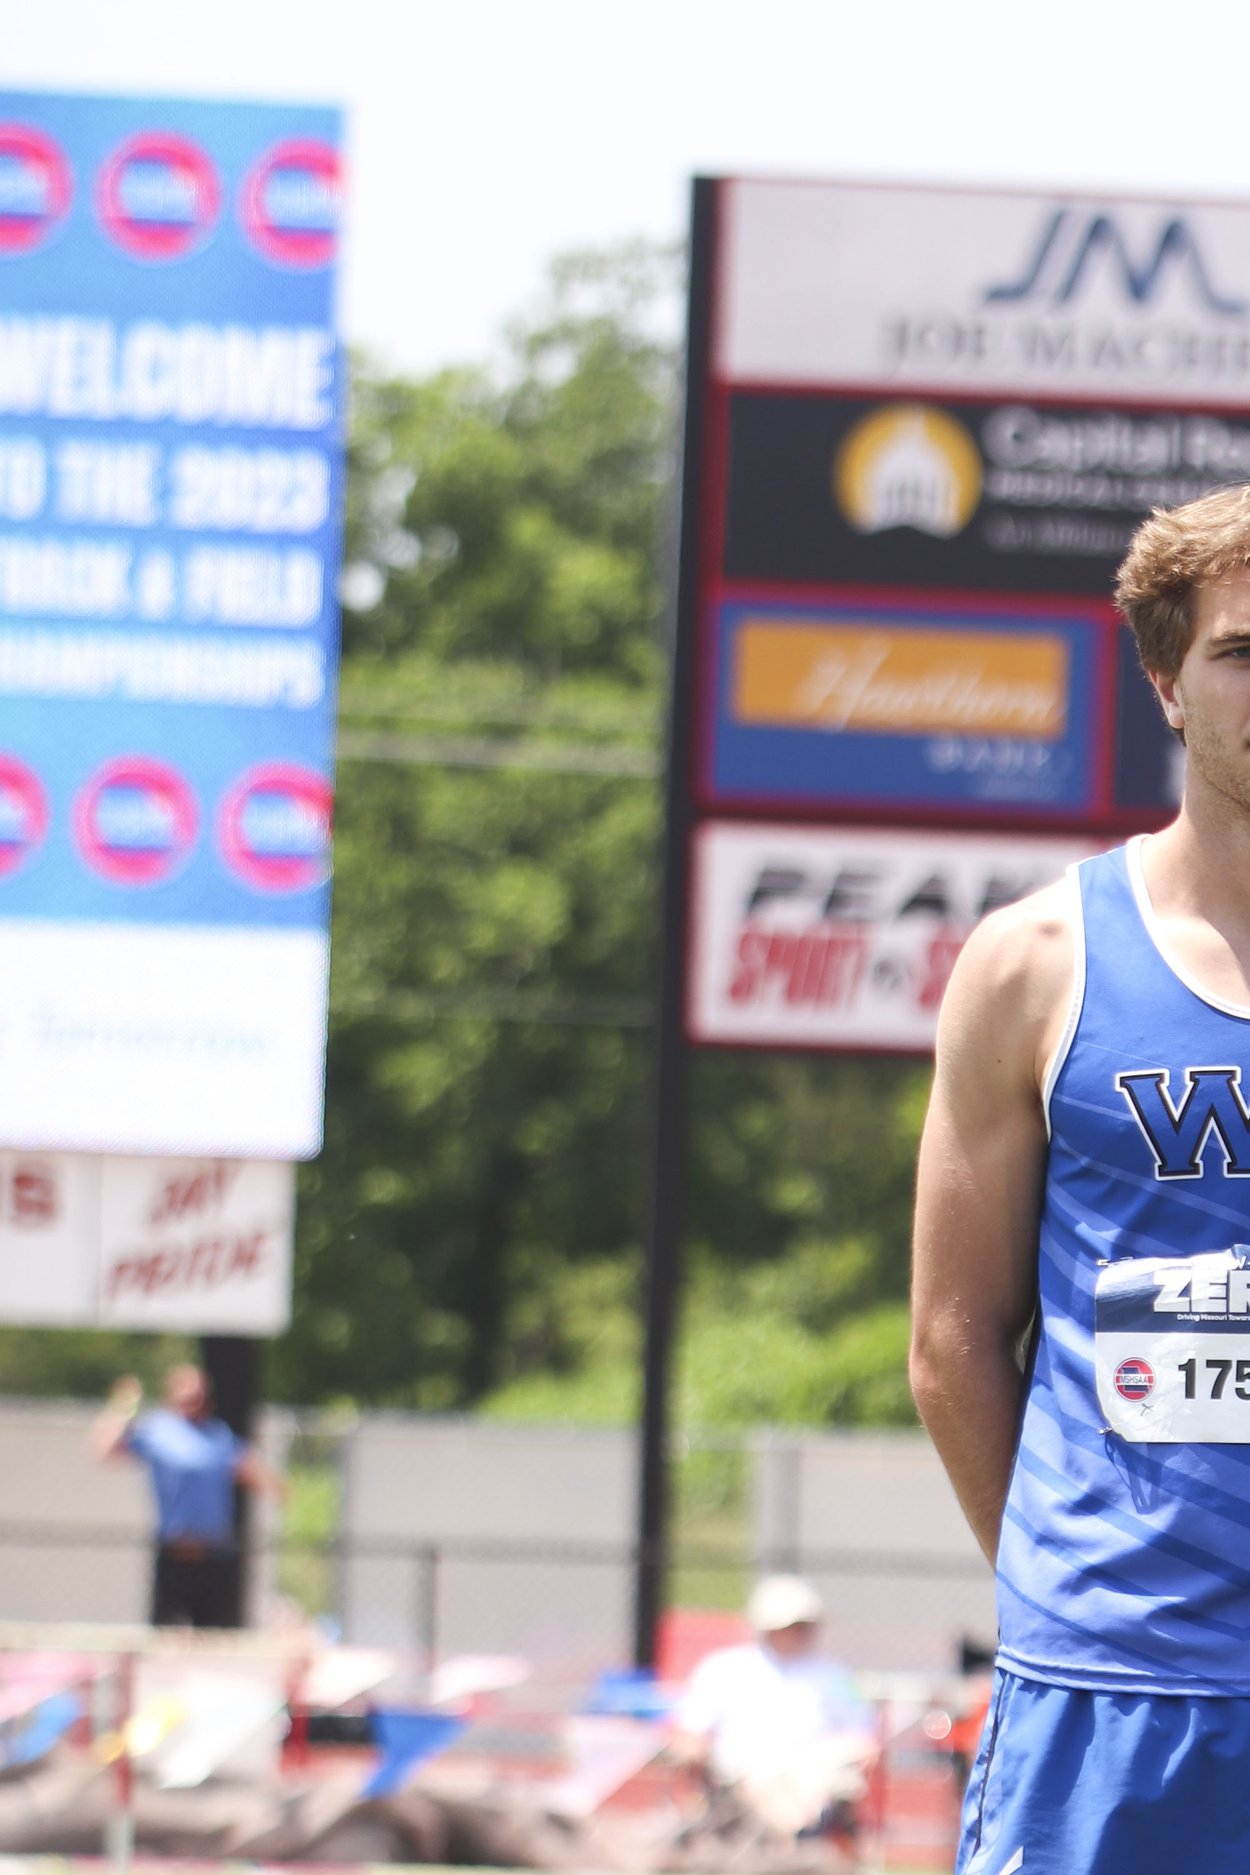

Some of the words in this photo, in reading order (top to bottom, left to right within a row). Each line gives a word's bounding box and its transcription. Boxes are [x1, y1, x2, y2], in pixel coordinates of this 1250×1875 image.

[884, 316, 988, 364] JOE
[53, 436, 163, 529] THE
[167, 447, 331, 535] 2023
[181, 550, 325, 630] FIELD
[1176, 1313, 1200, 1322] Driving
[1200, 1313, 1228, 1321] Missouri
[1120, 1373, 1148, 1385] MSHSAA
